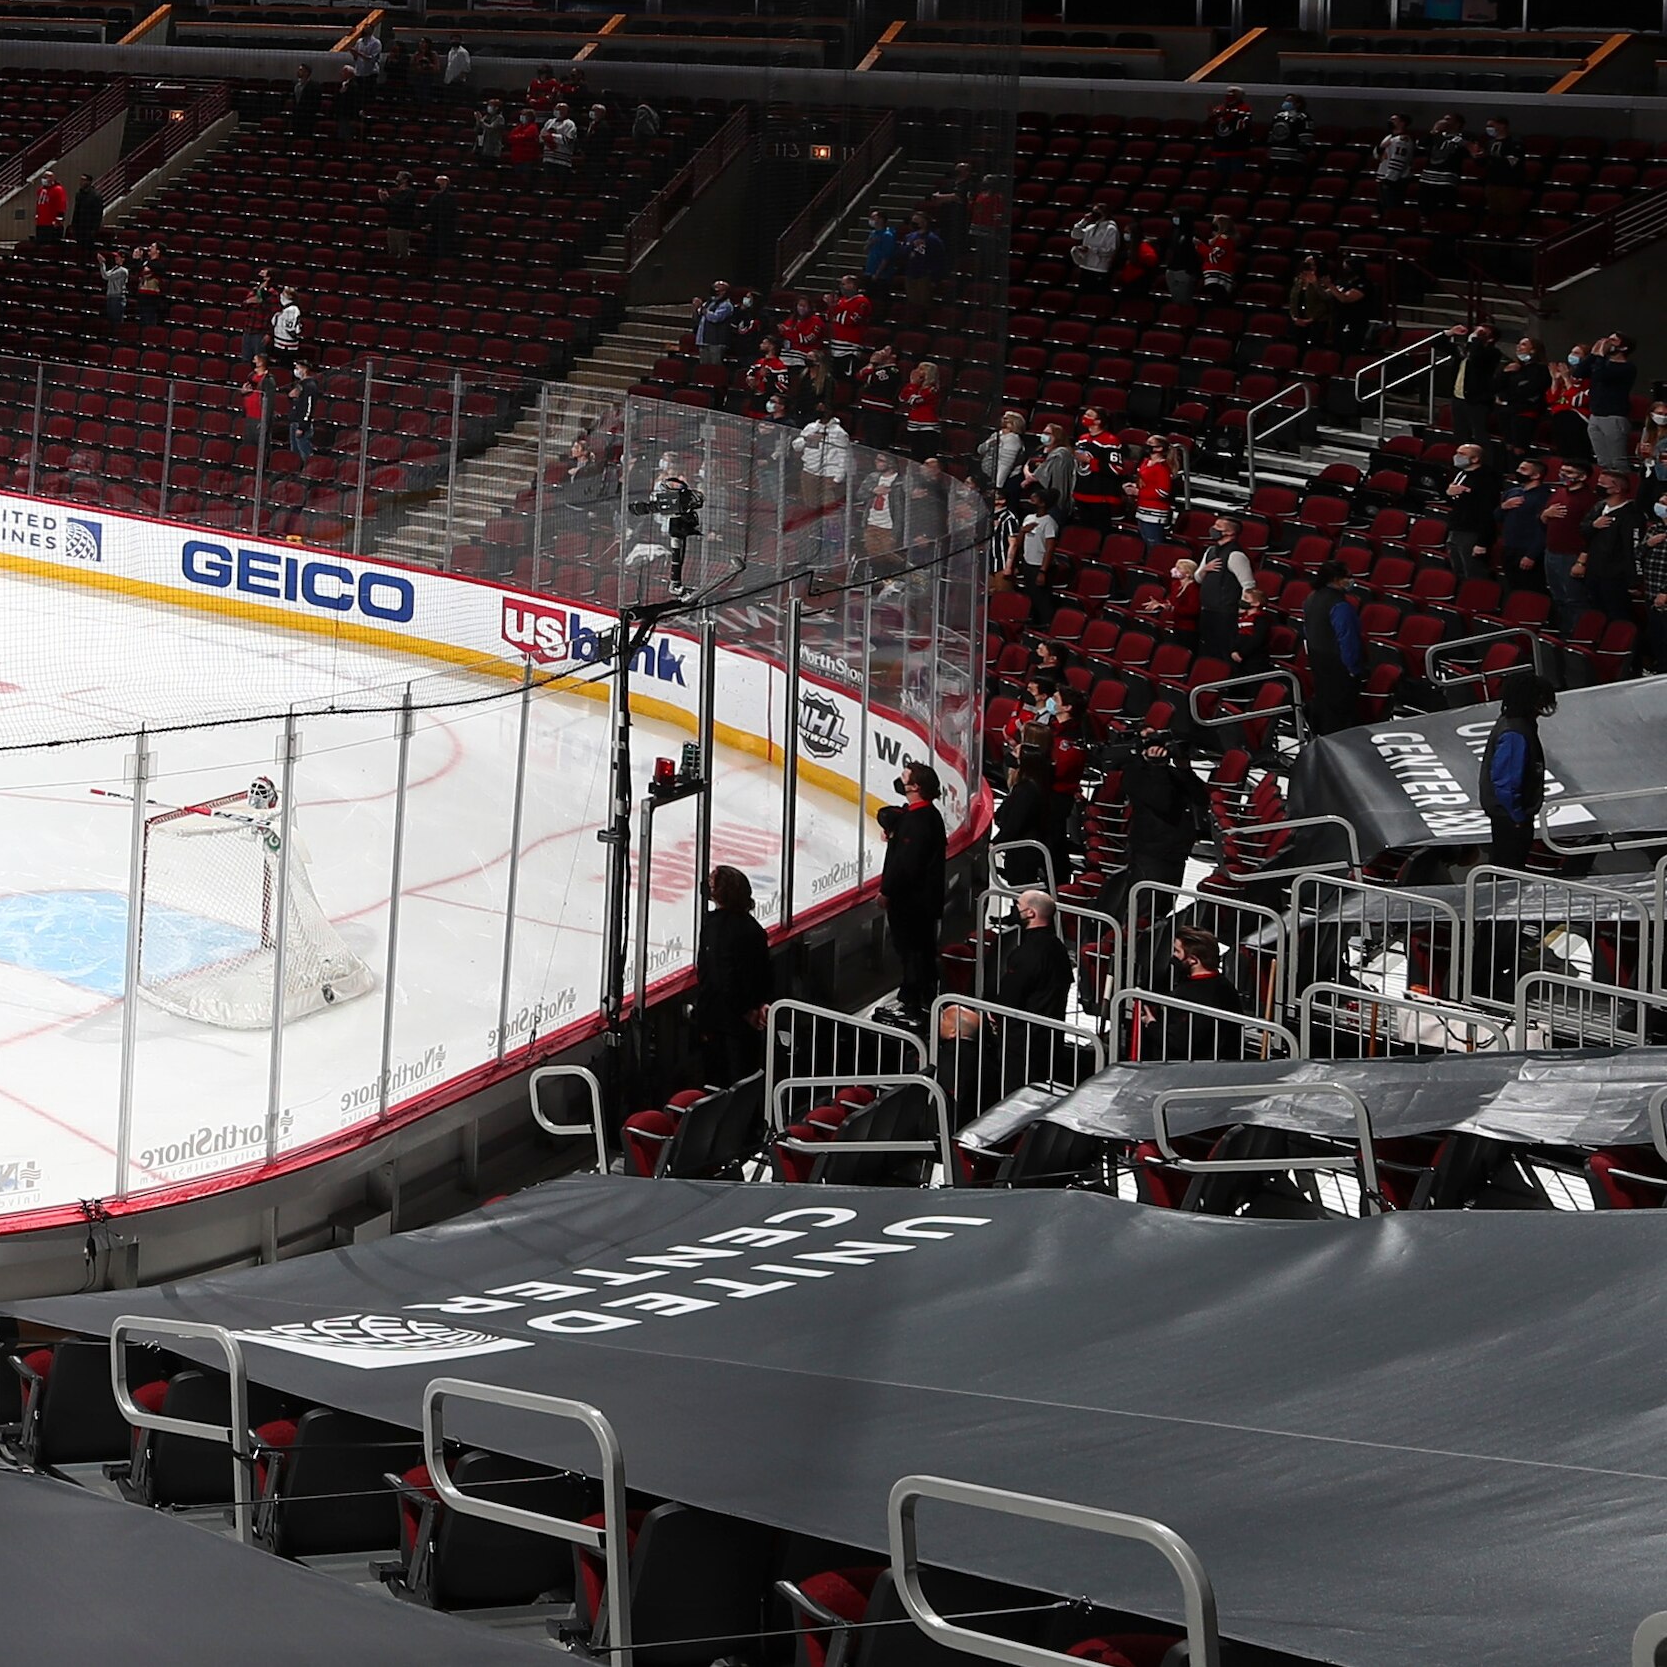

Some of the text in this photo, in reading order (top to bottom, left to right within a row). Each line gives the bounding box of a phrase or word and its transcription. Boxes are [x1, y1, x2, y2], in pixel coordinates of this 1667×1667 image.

[181, 539, 415, 624] GEICO
[798, 701, 850, 746] NHL
[1369, 730, 1472, 809] CENTER
[402, 1205, 859, 1316] CENTER
[525, 1214, 992, 1333] UNITED
